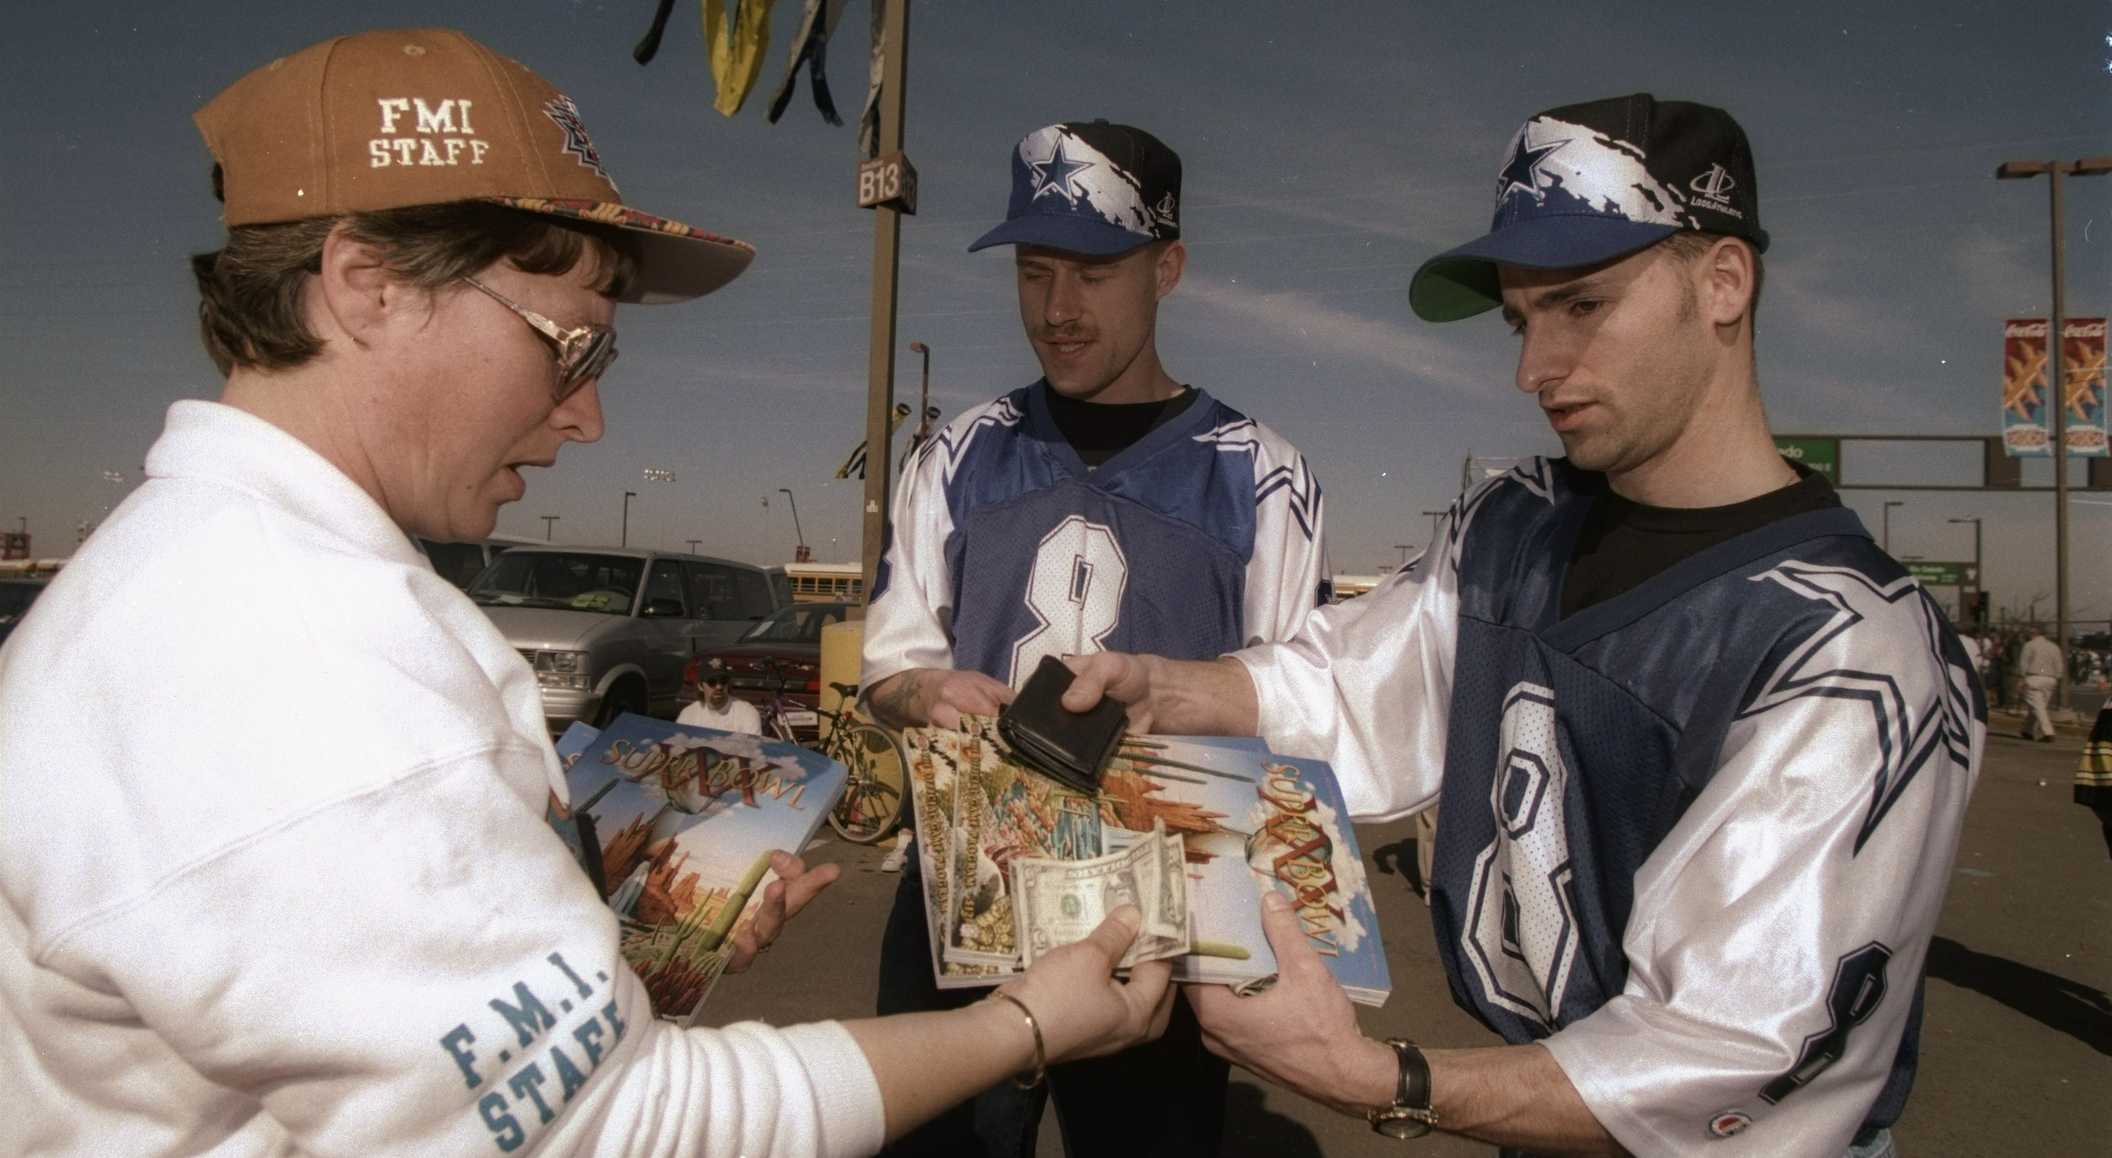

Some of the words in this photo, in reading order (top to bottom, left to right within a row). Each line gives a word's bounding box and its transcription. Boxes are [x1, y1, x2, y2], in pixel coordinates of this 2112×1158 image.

[378, 97, 475, 134] FMI
[369, 138, 489, 168] STAFF
[859, 162, 899, 204] B13
[600, 739, 697, 778] SUPER
[706, 759, 806, 810] BOWL
[968, 798, 979, 827] GAME
[1261, 762, 1313, 845] SUPER
[930, 822, 943, 852] GAME
[965, 832, 978, 888] PROGRAM
[1461, 680, 1580, 1034] 8
[934, 856, 948, 912] PROGRAM
[439, 951, 609, 1090] F.M.I.
[478, 999, 625, 1153] STAFF
